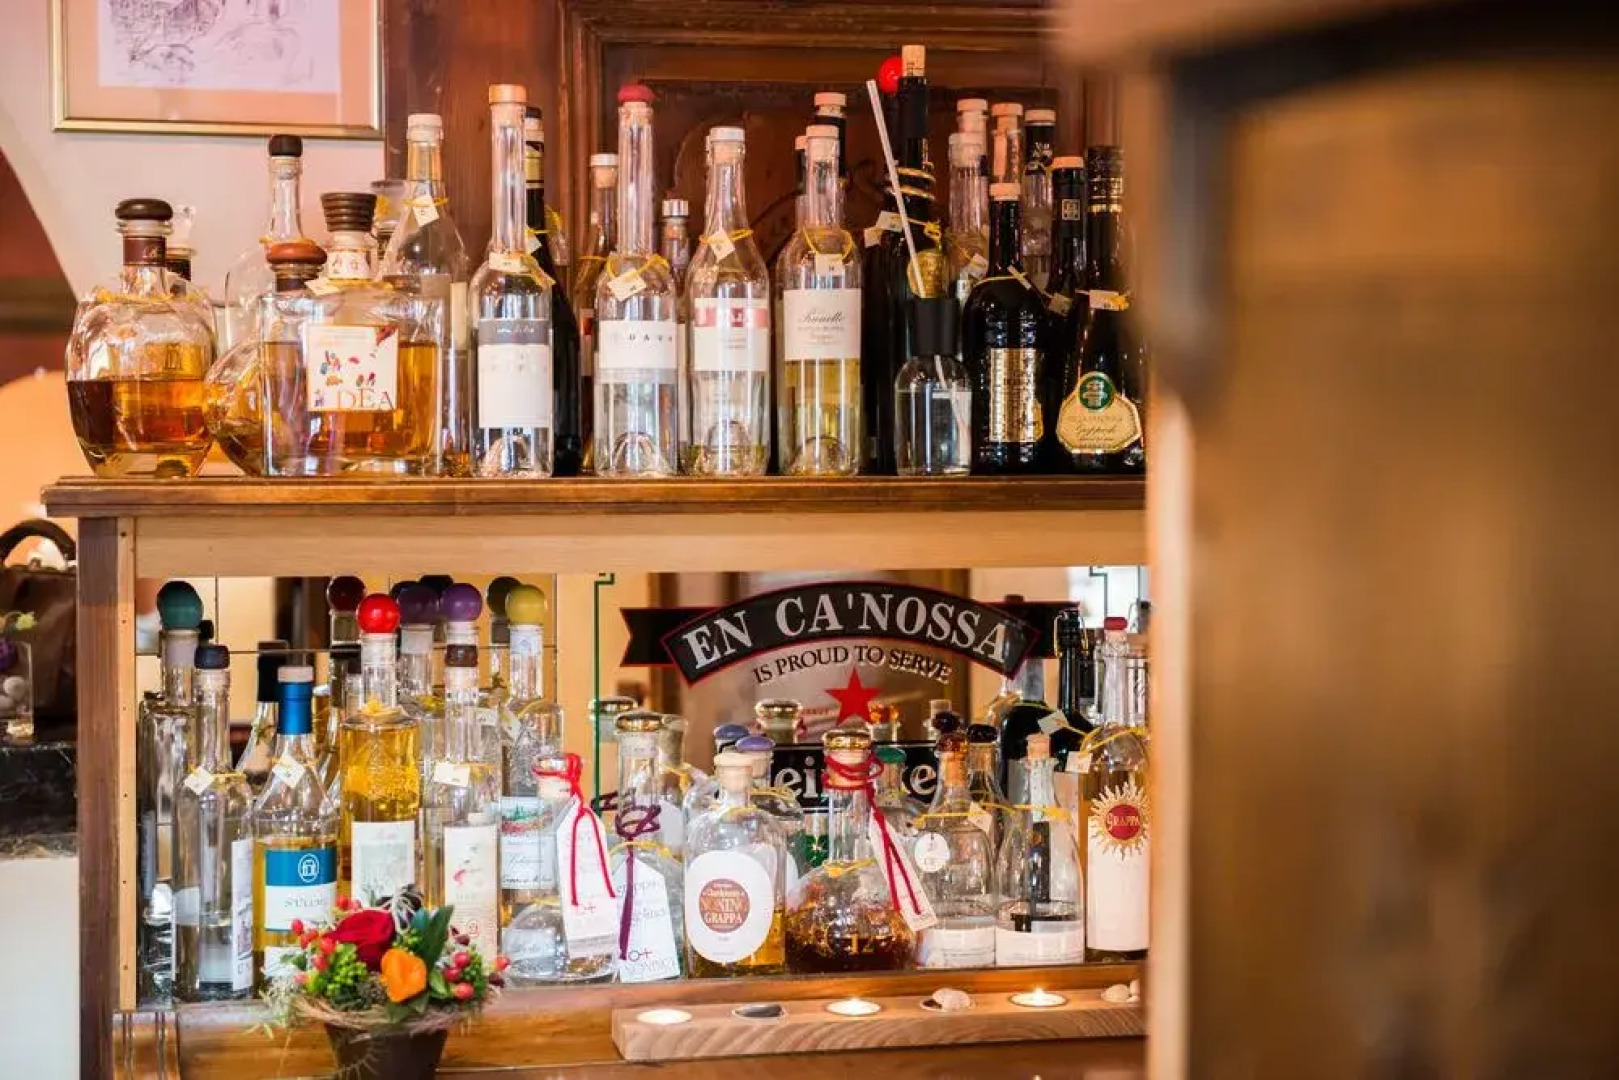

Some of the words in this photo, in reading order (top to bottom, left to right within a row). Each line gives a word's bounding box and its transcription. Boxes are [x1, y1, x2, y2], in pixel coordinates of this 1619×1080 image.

[682, 609, 754, 670] EN
[775, 591, 1006, 664] CA'NOSSA
[753, 663, 773, 685] IS
[775, 645, 850, 677] PROUD
[854, 645, 885, 664] TO
[888, 648, 951, 684] SERVE
[704, 912, 743, 924] GRAPPA
